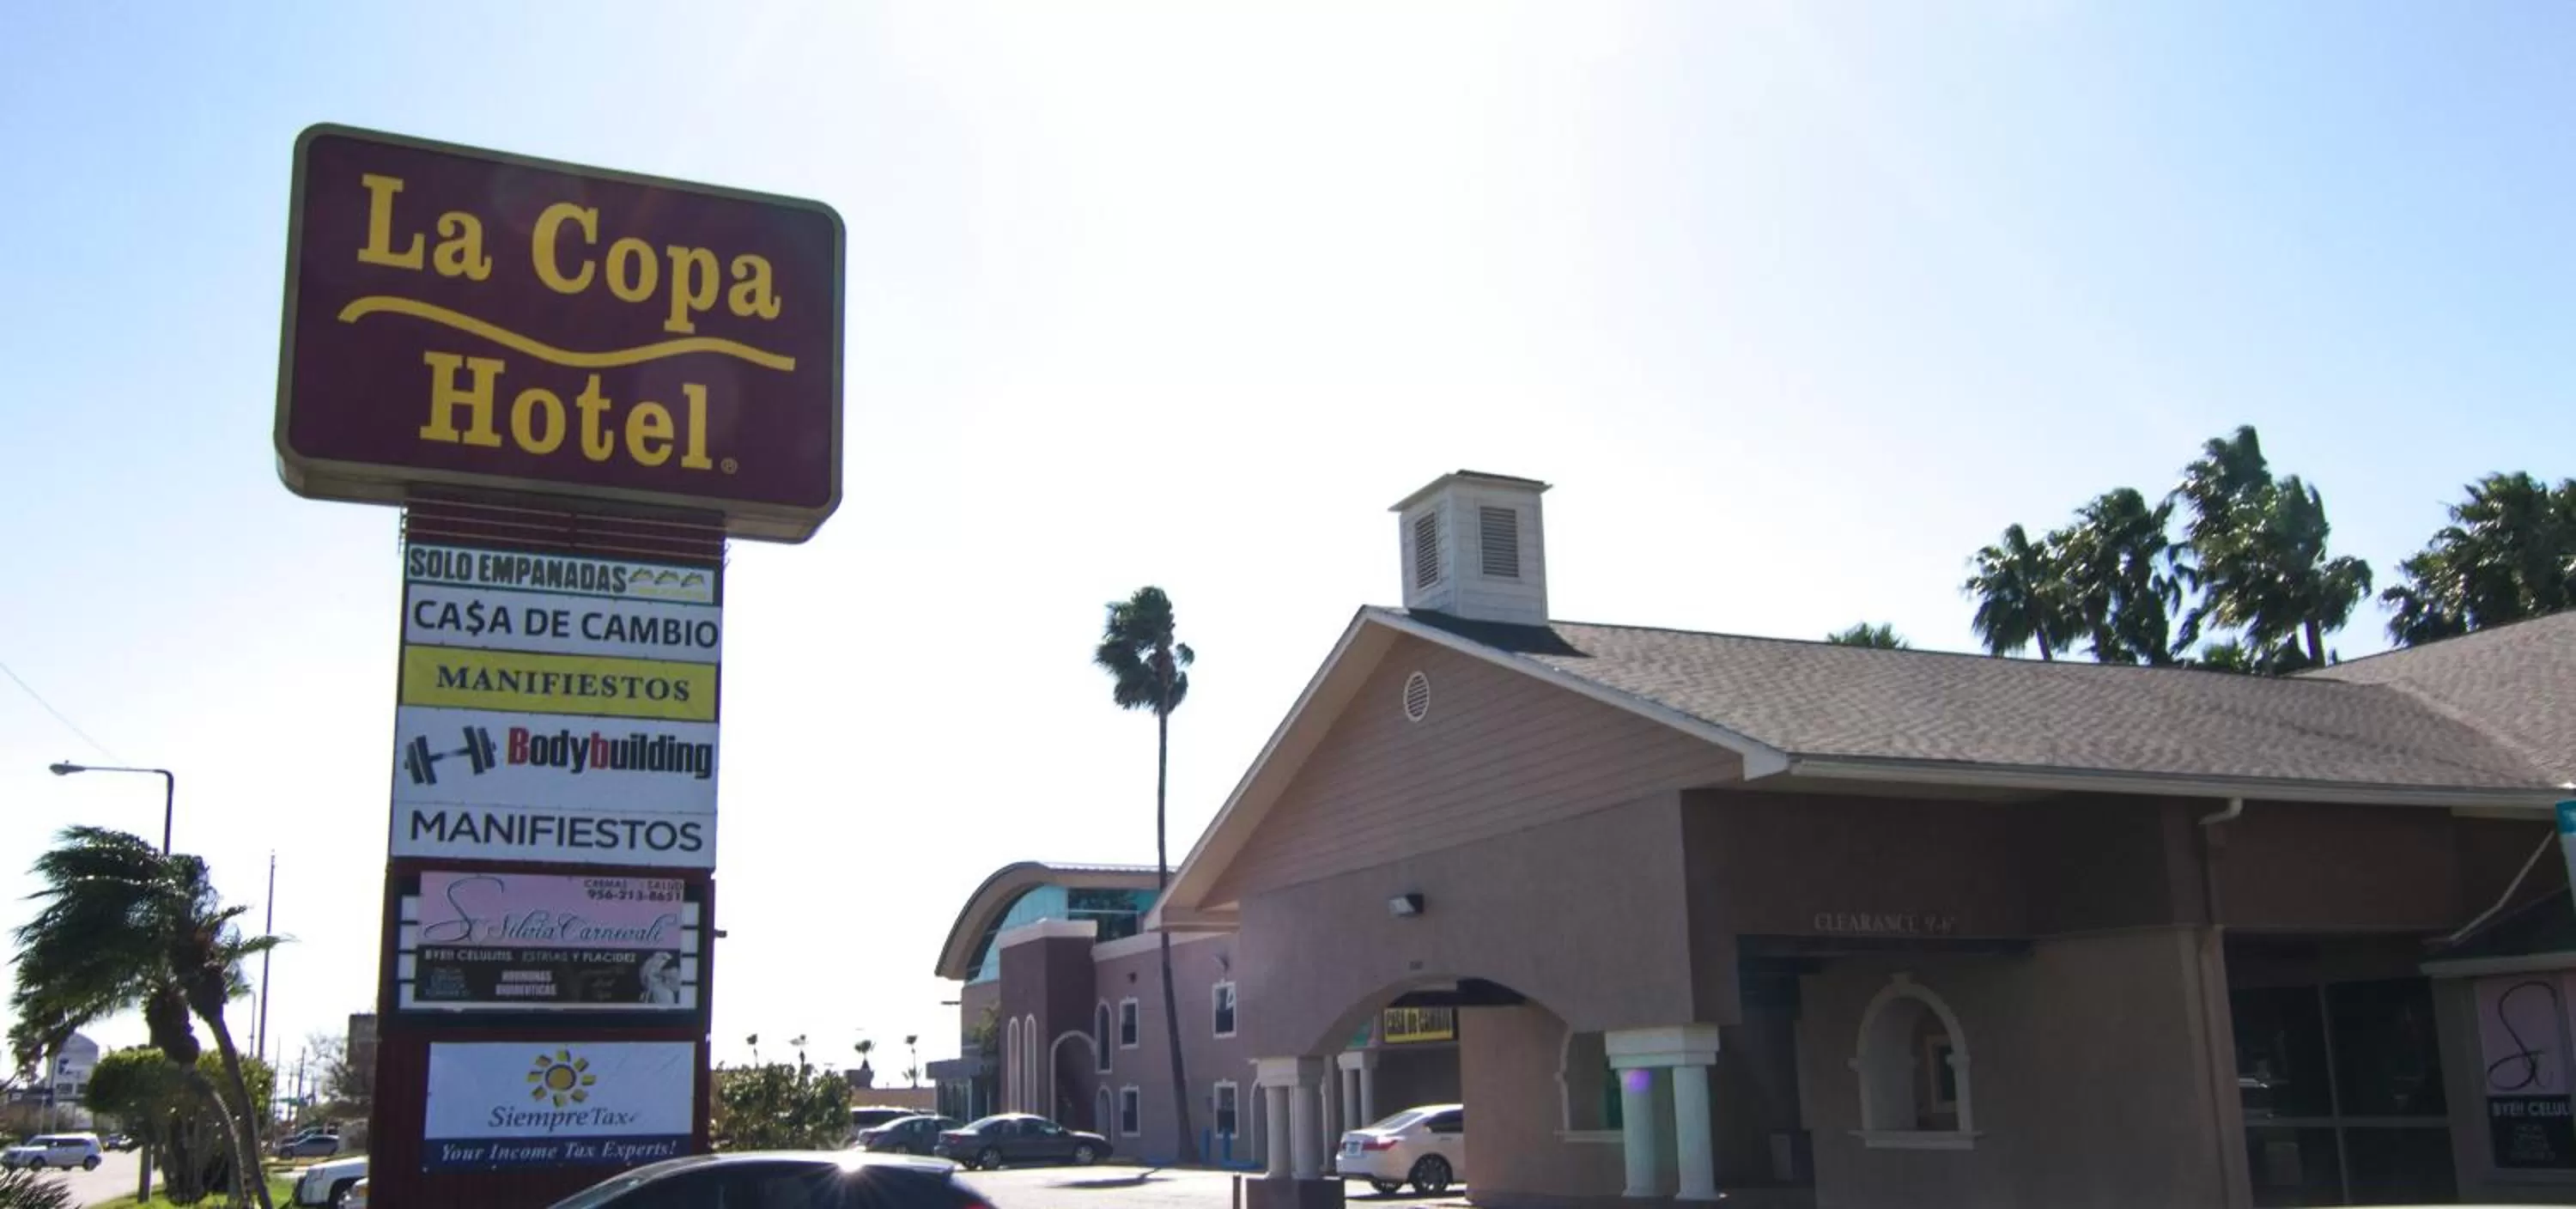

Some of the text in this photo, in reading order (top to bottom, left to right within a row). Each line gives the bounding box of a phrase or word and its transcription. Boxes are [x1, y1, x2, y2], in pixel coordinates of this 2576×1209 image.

[358, 173, 781, 334] La Copa
[420, 350, 713, 471] Hotel
[410, 547, 628, 594] SOLO EMPANADAS
[414, 599, 719, 648] CA$A DE CAMBIO
[436, 665, 691, 702] MANIFIESTOS
[508, 726, 713, 780] Bodybuilding
[410, 810, 703, 852] MANIFIESTOS
[486, 908, 556, 942] Silvia
[1814, 912, 1919, 933] CLEARANCE
[440, 1139, 677, 1162] Your Income Tax Experts!
